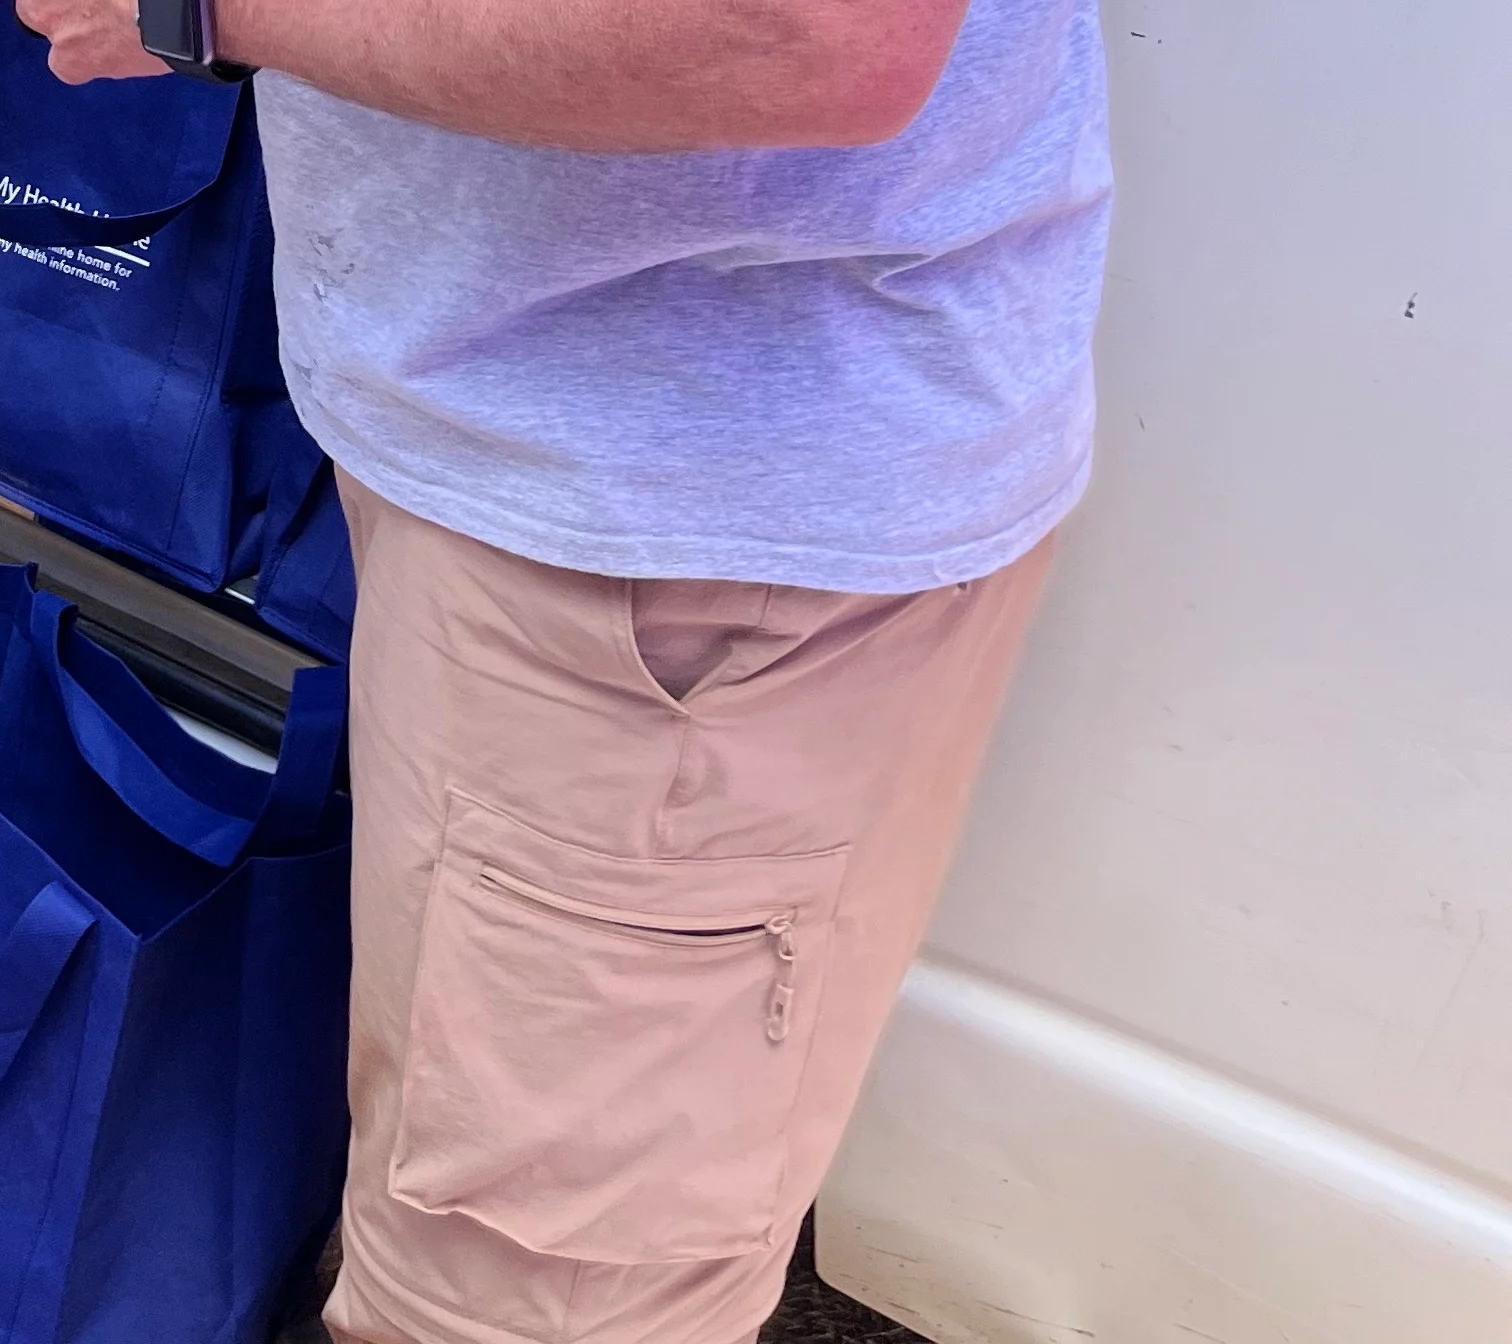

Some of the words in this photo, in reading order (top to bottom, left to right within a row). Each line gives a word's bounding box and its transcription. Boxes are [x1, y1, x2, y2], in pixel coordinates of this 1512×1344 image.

[14, 242, 48, 265] health
[76, 249, 112, 272] home
[114, 262, 133, 278] for
